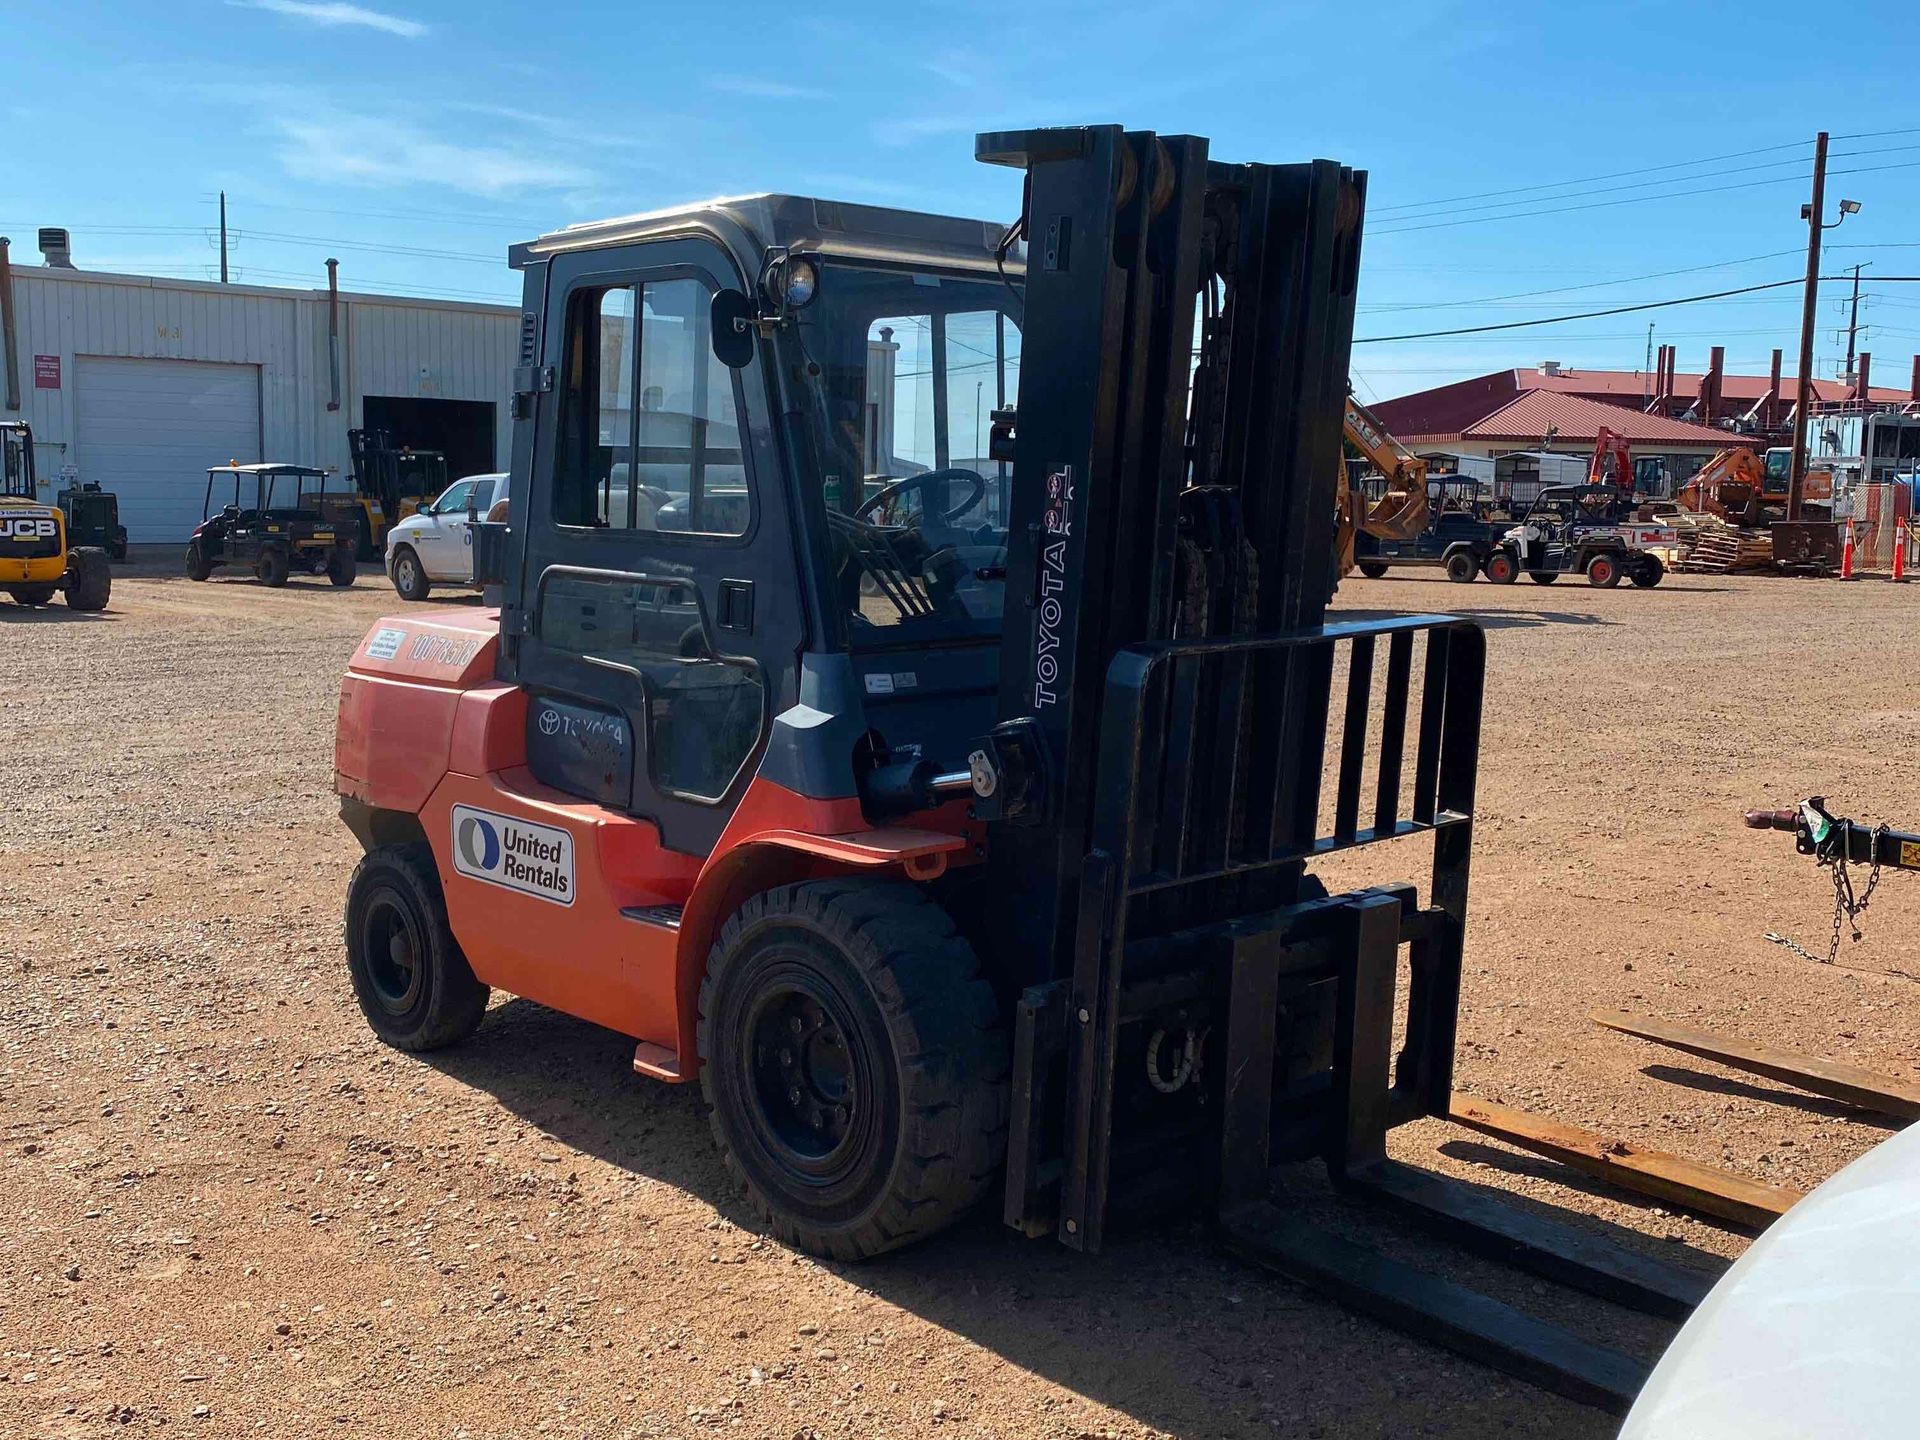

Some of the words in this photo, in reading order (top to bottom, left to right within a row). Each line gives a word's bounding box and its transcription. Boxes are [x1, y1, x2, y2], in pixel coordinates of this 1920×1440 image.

[1345, 411, 1382, 449] CASE
[0, 520, 56, 537] JCB
[1035, 541, 1066, 709] TOYOTA
[408, 633, 479, 667] 10078518
[503, 826, 562, 864] United
[503, 853, 568, 893] Rentals
